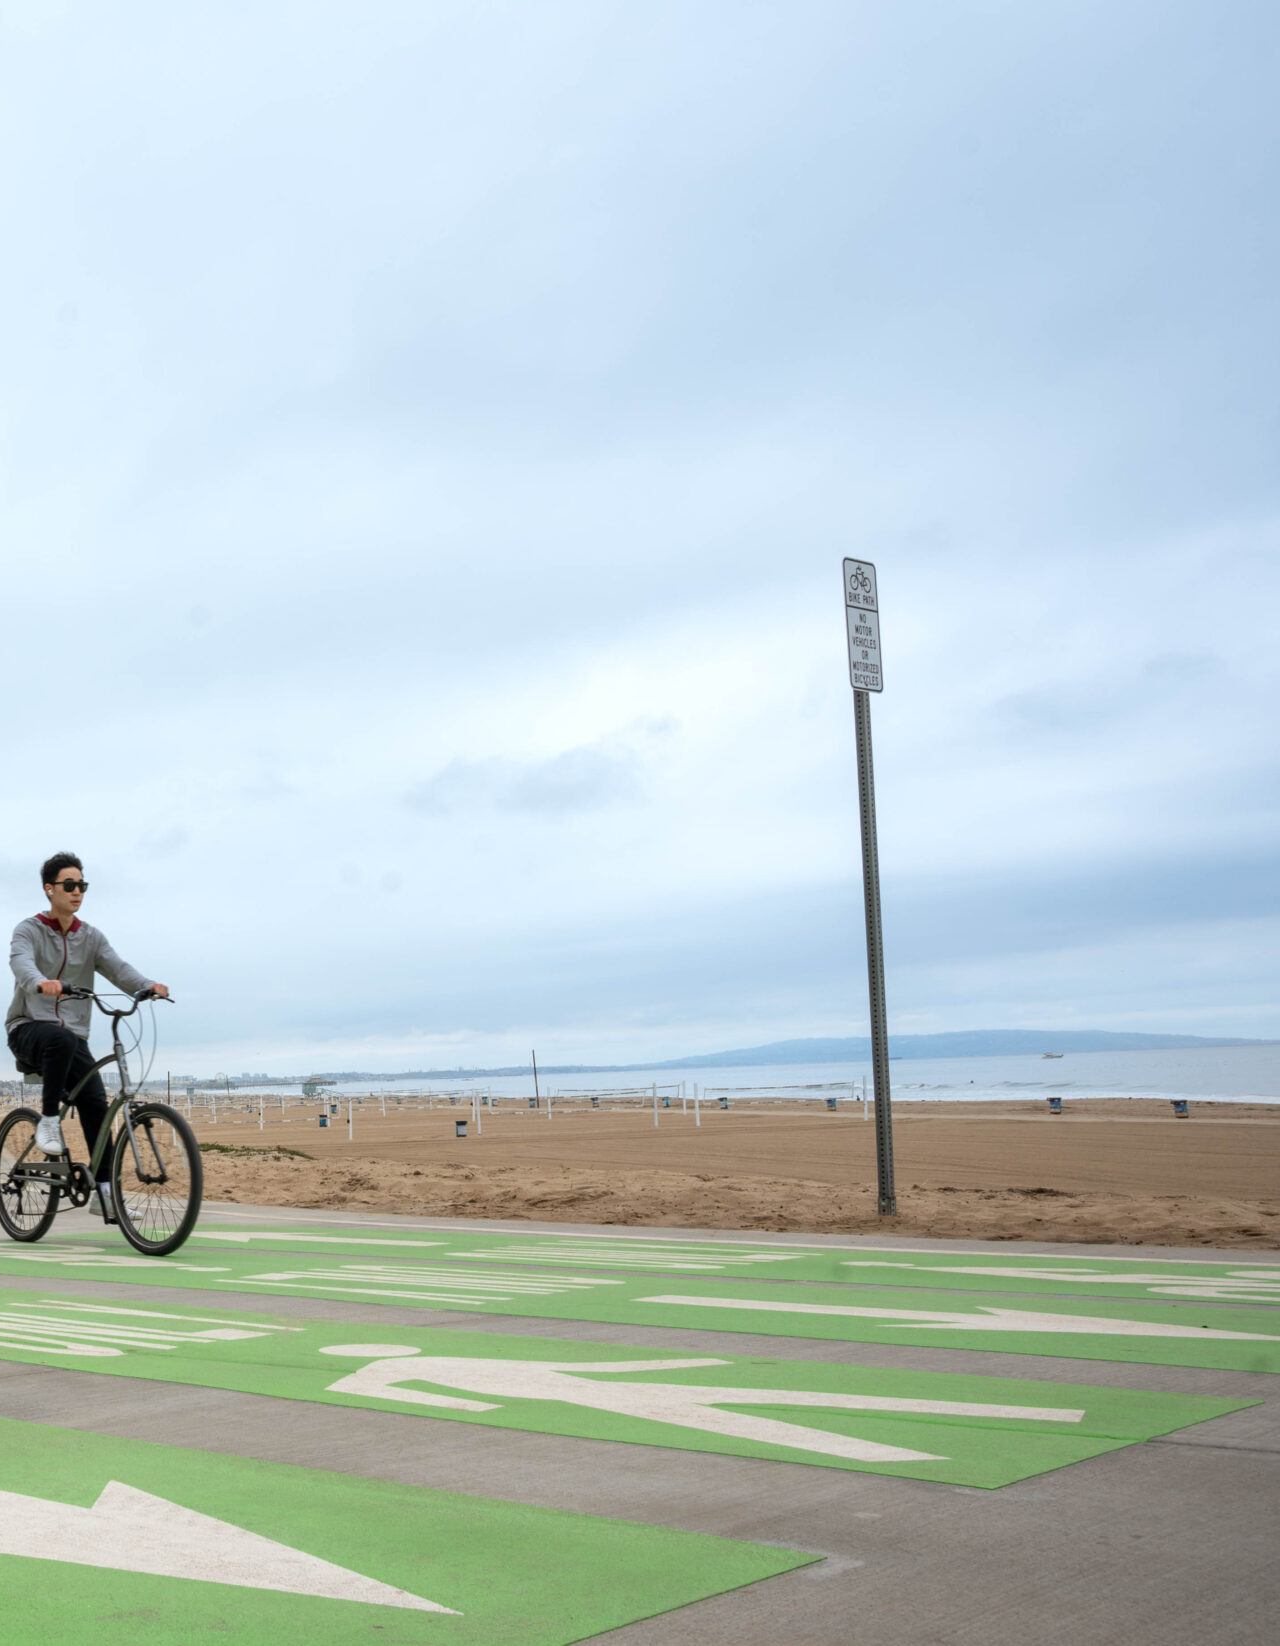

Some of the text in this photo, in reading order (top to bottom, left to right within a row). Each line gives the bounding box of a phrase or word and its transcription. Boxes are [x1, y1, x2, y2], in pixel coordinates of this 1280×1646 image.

[849, 592, 874, 606] BIKE PATH
[859, 613, 866, 623] NO
[855, 625, 872, 636] MOTOR
[853, 636, 876, 649] VEHICLES
[862, 650, 868, 660] OR
[853, 661, 879, 674] MOTORIZED
[854, 672, 879, 687] BICYCLES
